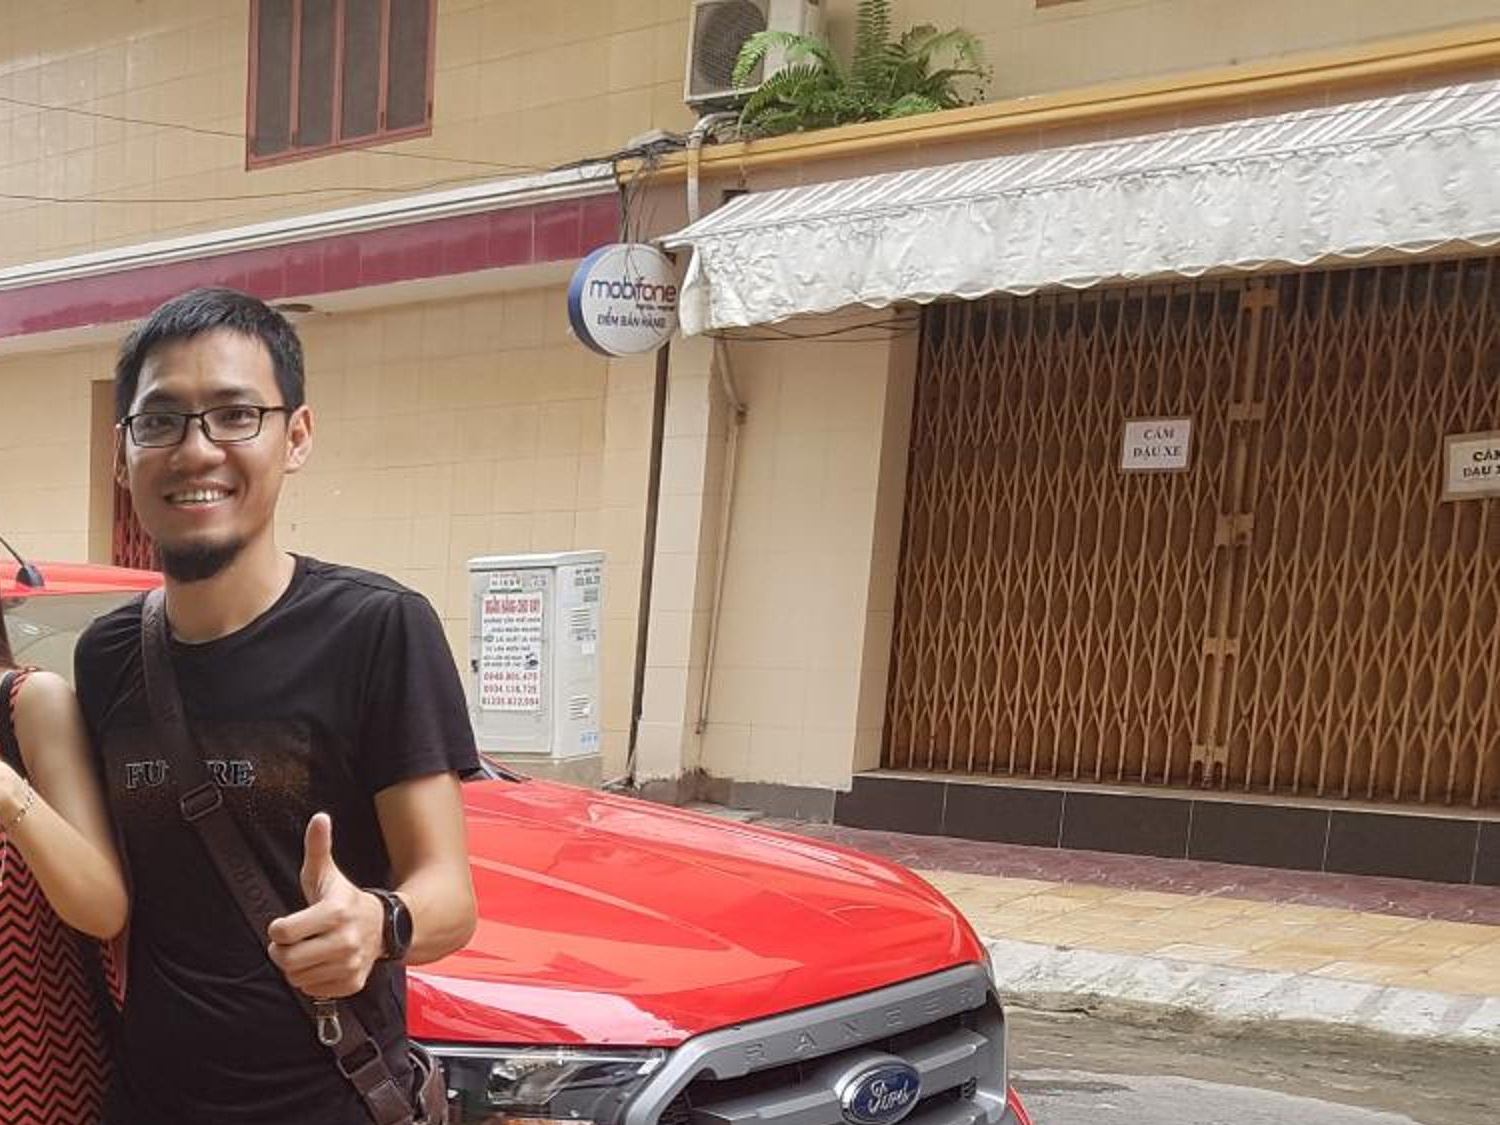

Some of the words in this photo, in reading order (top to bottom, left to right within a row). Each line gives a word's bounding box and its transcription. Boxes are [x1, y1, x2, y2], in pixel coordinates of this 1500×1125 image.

[590, 275, 677, 303] mobifone
[1163, 444, 1182, 457] XE
[125, 759, 257, 789] FURE
[745, 985, 978, 1066] RANGER
[867, 1078, 919, 1115] Ford
